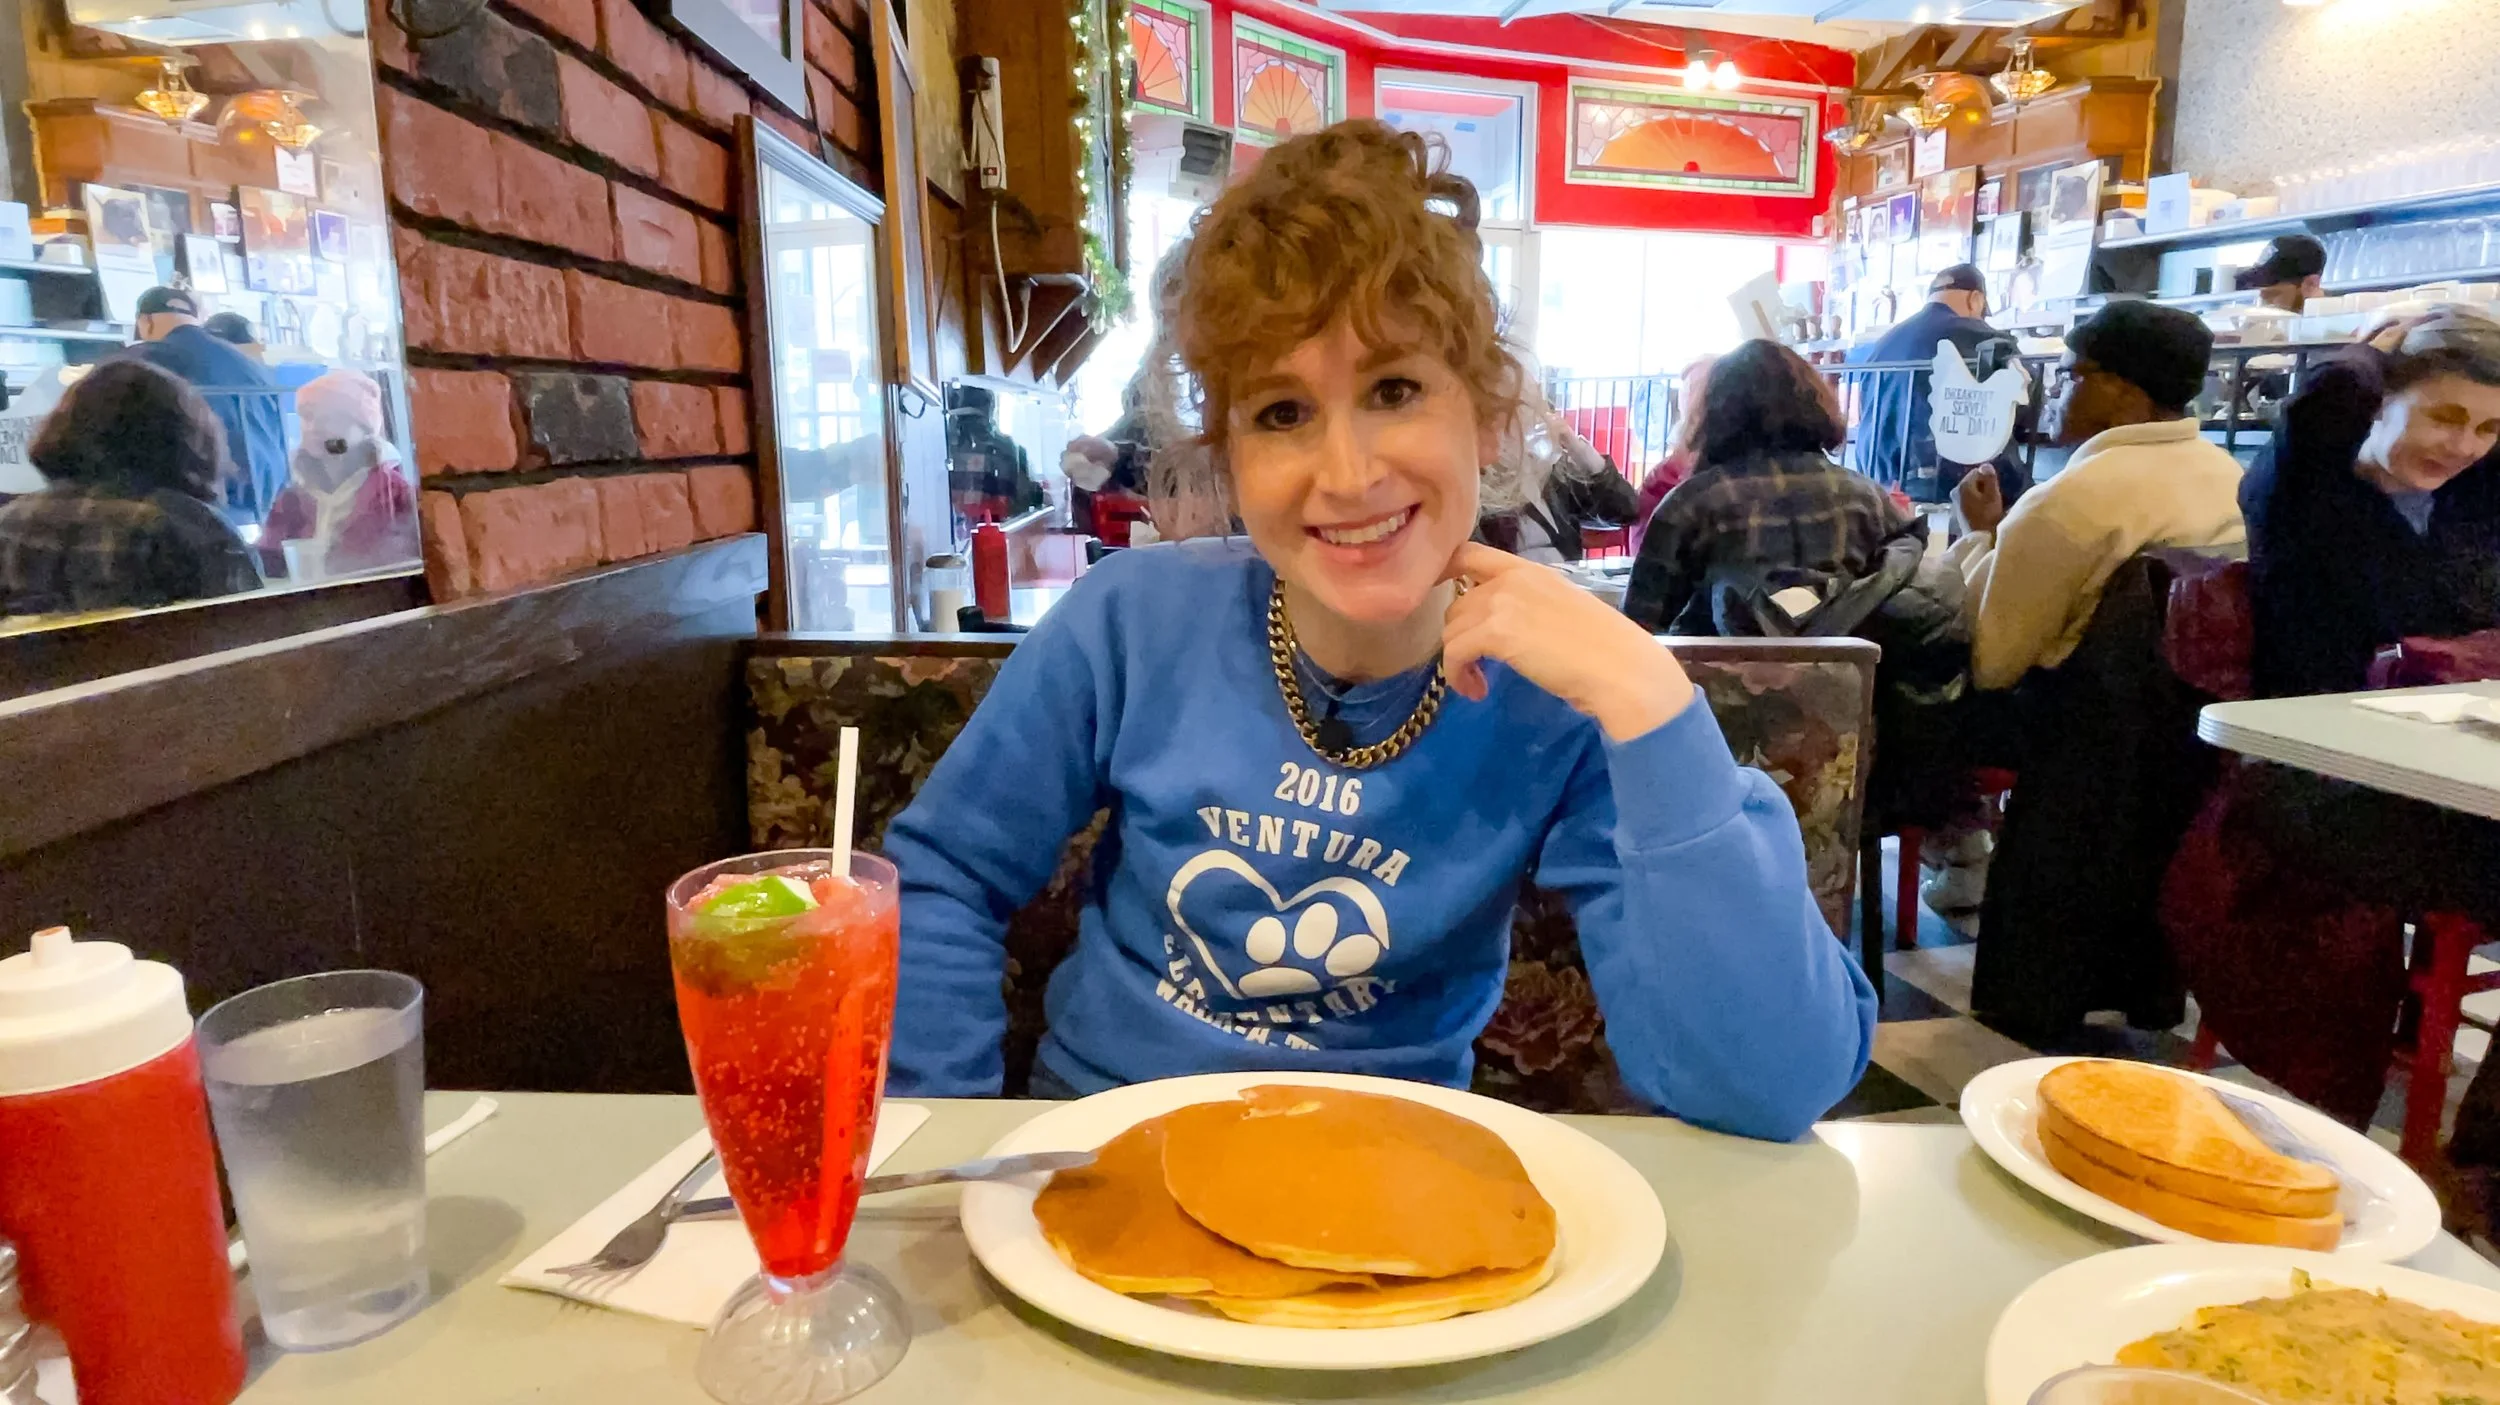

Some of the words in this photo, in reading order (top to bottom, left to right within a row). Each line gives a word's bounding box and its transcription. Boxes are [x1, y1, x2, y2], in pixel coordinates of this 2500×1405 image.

[1939, 416, 1959, 434] ALL
[1967, 416, 1996, 436] DAY!
[1274, 761, 1362, 815] 2016
[1197, 806, 1411, 887] VENTURA
